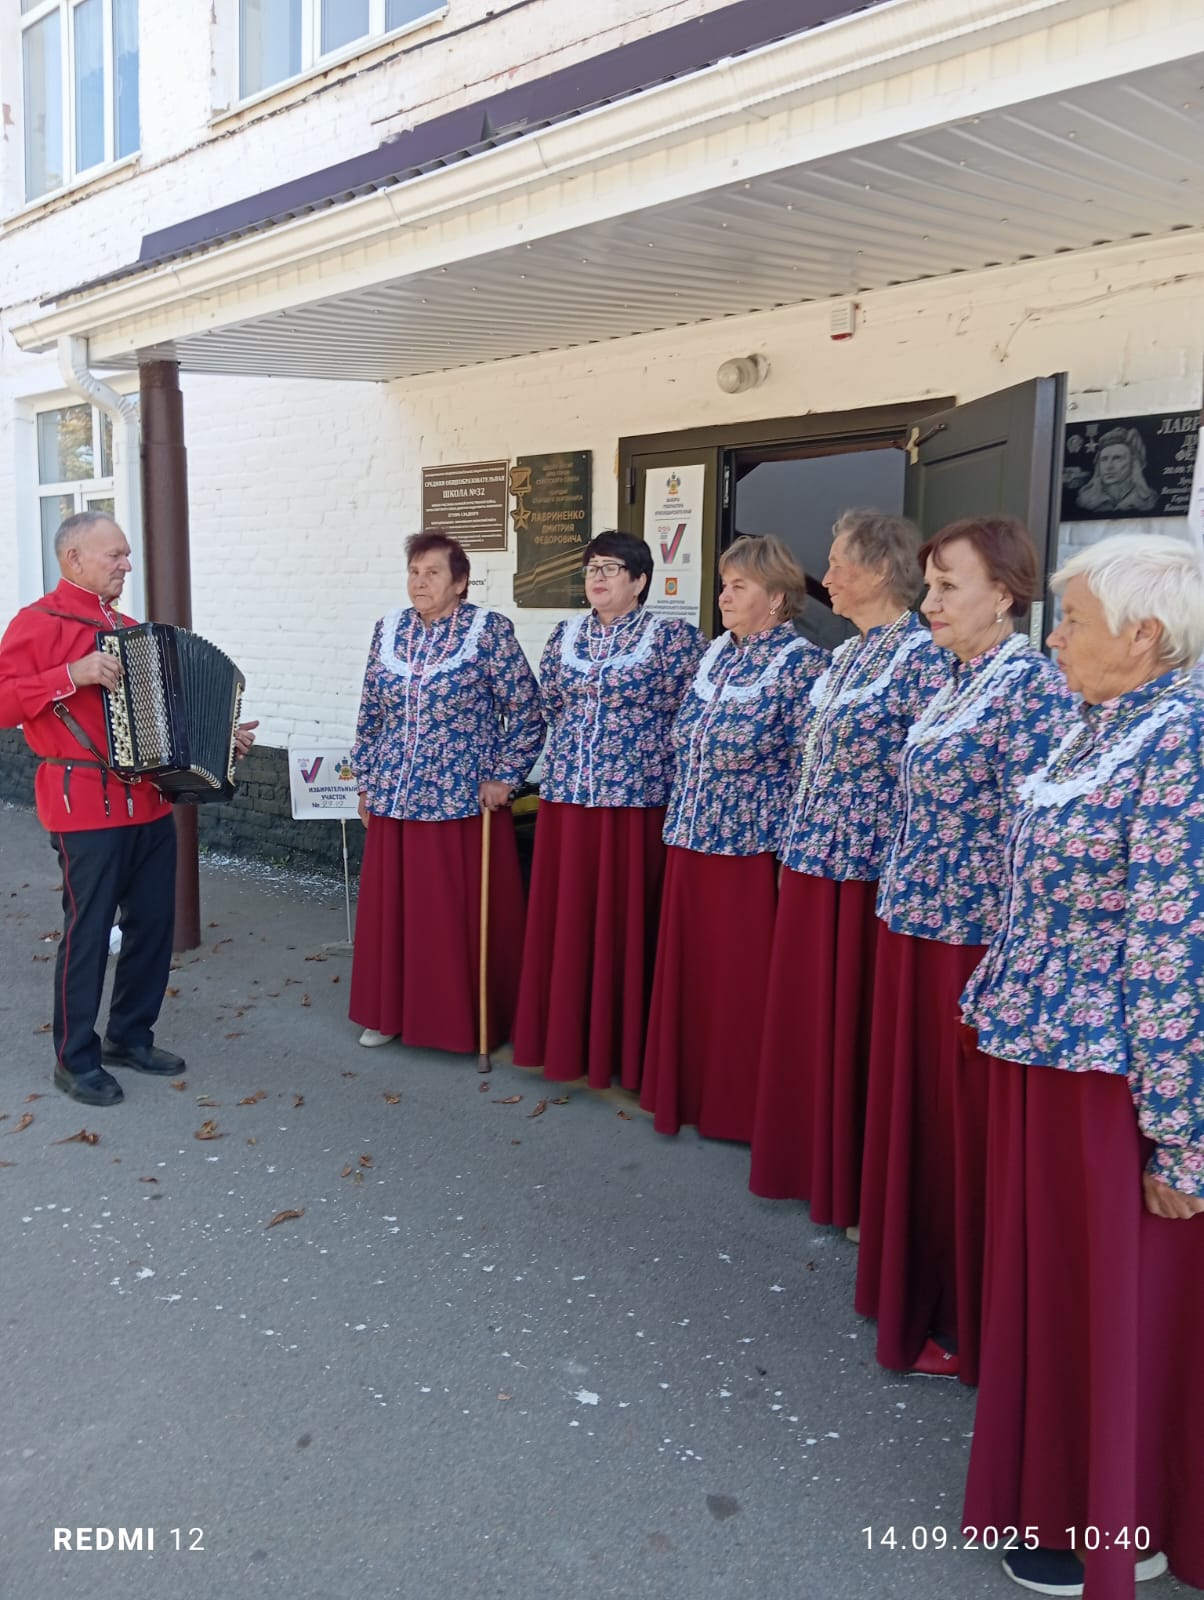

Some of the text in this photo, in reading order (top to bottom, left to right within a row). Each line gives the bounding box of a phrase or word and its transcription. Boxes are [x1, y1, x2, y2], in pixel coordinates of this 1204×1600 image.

[443, 487, 486, 499] ШКОЛА №32
[530, 510, 585, 523] ЛАВРИНЕНКО
[541, 523, 575, 534] ДМИТРИЯ
[534, 534, 583, 544] ФЕДОРОВИЧА
